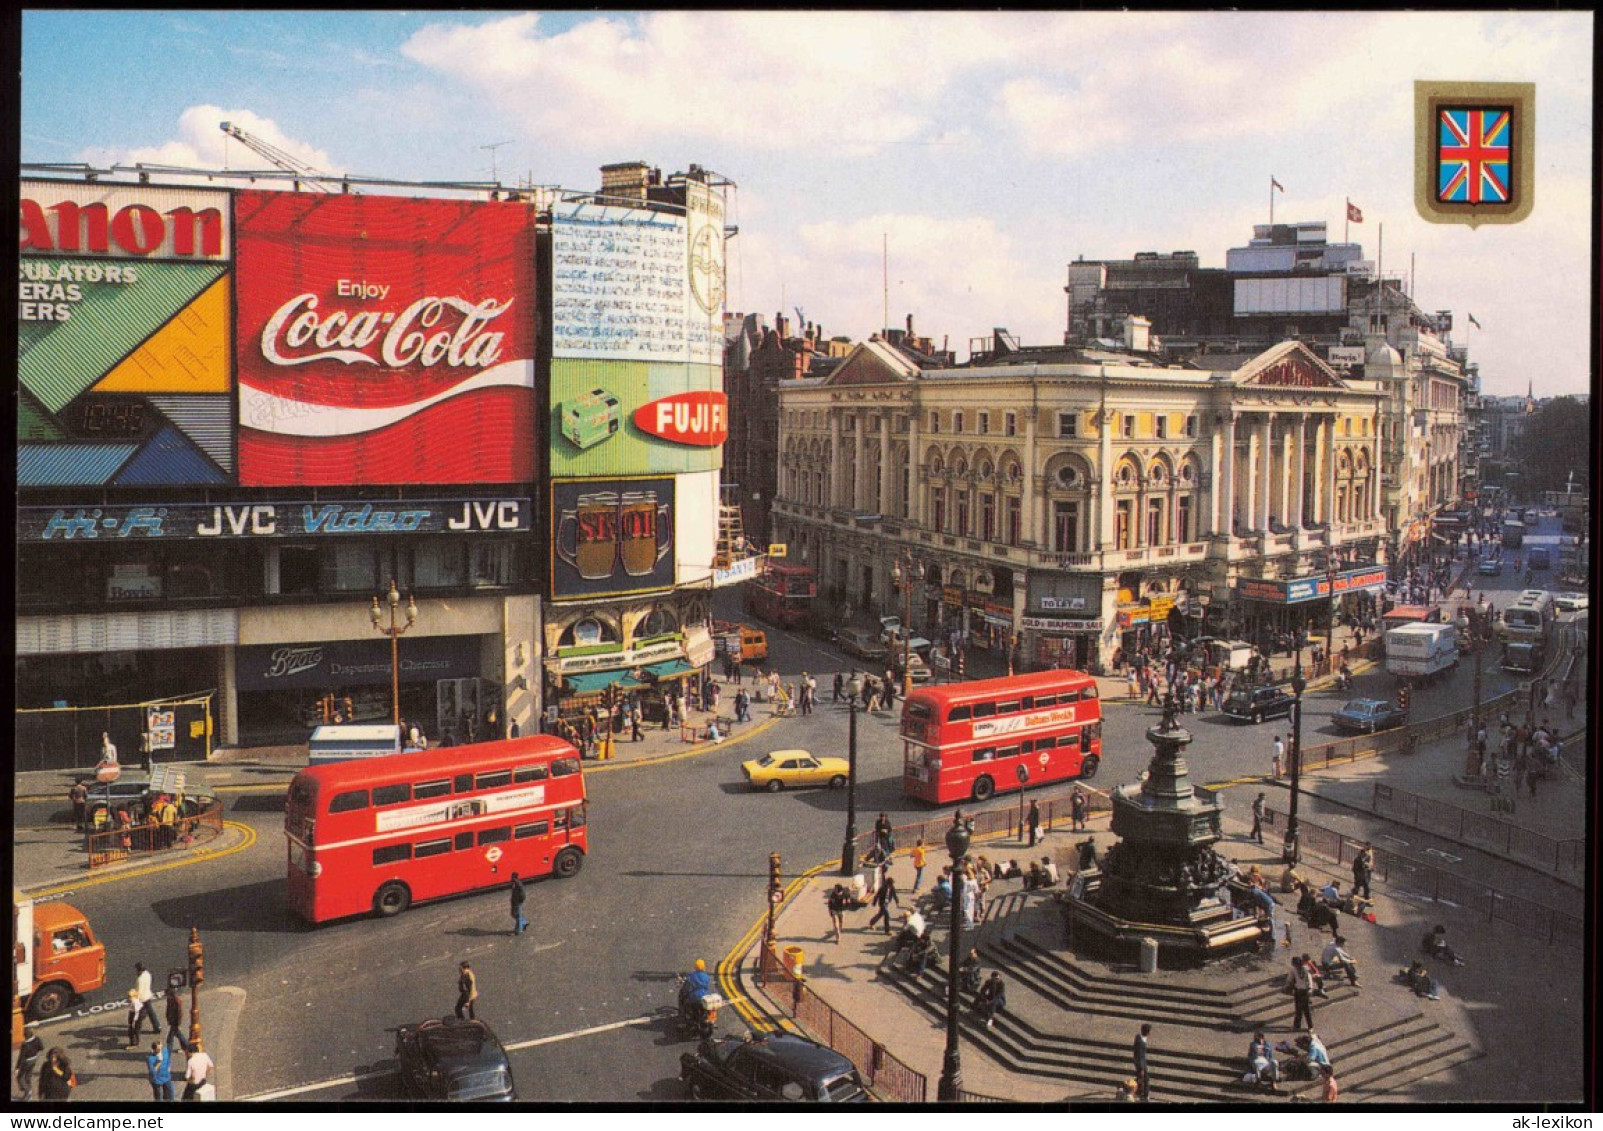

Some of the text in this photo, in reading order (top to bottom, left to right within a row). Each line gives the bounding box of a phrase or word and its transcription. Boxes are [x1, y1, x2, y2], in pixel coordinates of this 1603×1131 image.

[336, 279, 391, 300] Enjoy
[261, 293, 515, 367] Coca-Cola
[656, 402, 709, 434] FUJI
[42, 501, 519, 539] Hi-Fi JVC Video JVC
[78, 998, 130, 1017] LOOK
